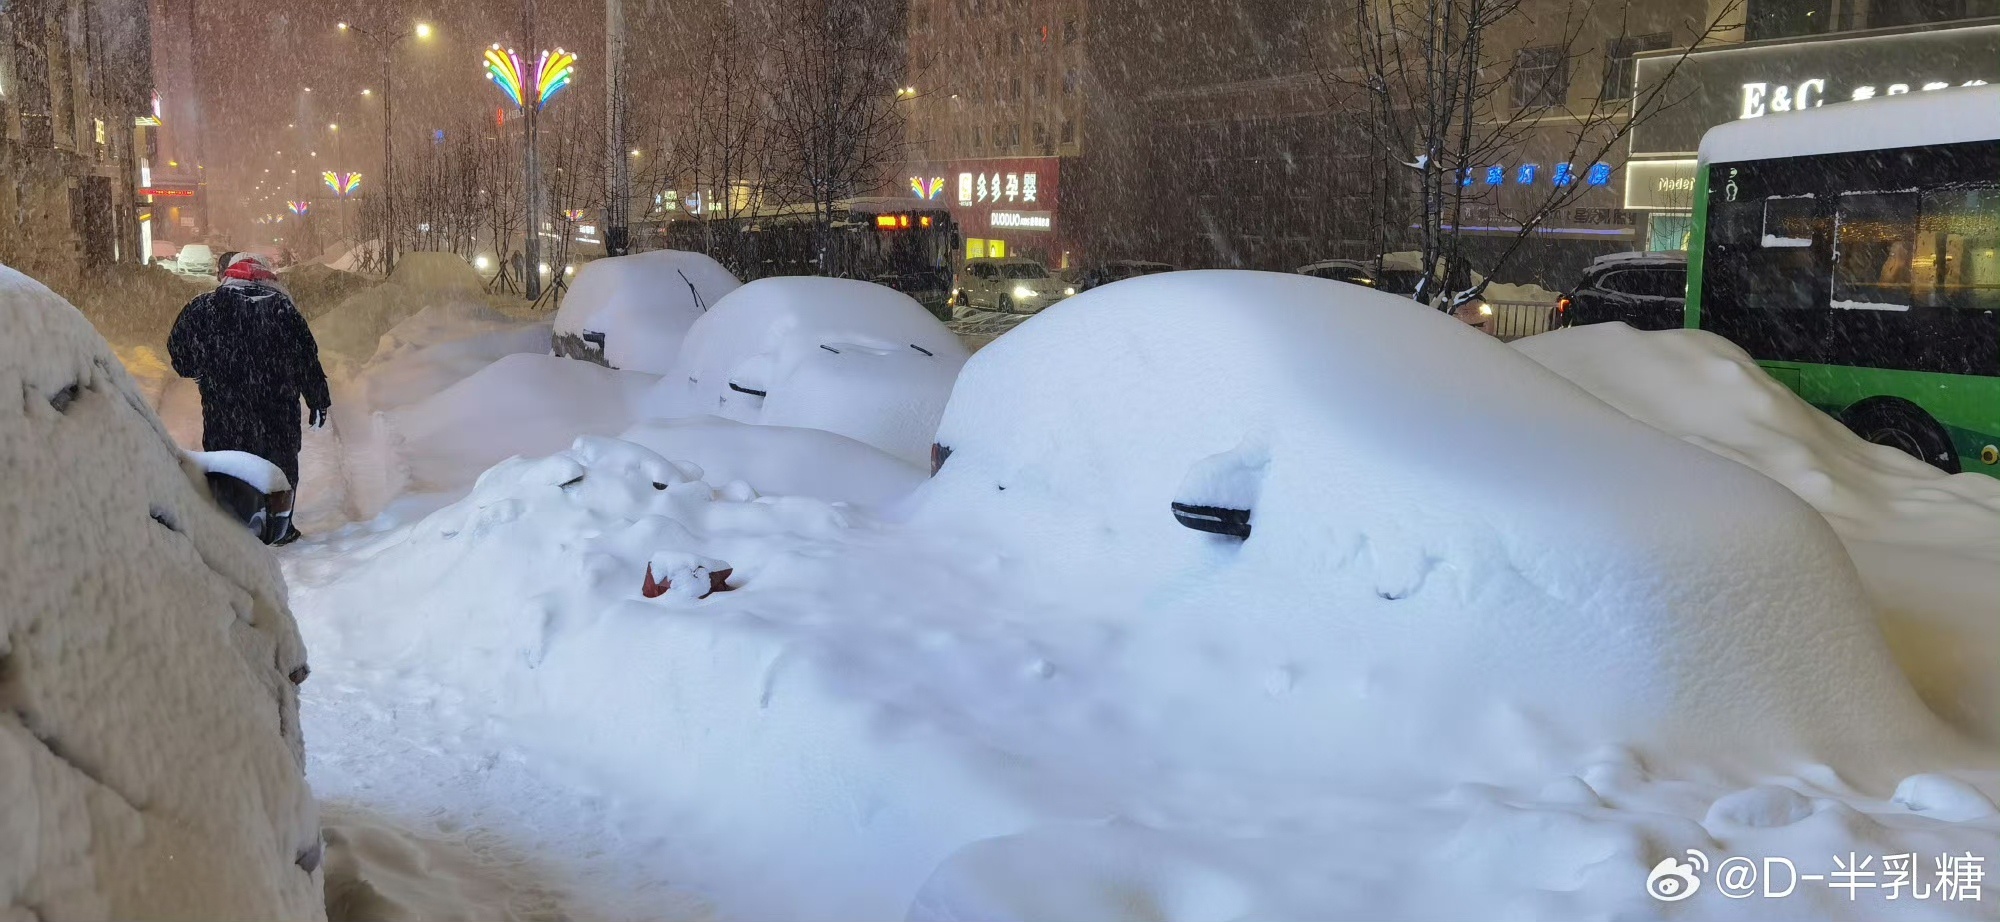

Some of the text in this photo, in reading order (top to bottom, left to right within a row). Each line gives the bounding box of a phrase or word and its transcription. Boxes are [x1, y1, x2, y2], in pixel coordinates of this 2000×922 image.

[1739, 79, 1825, 119] E&C
[977, 172, 1037, 203] 多多孕婴
